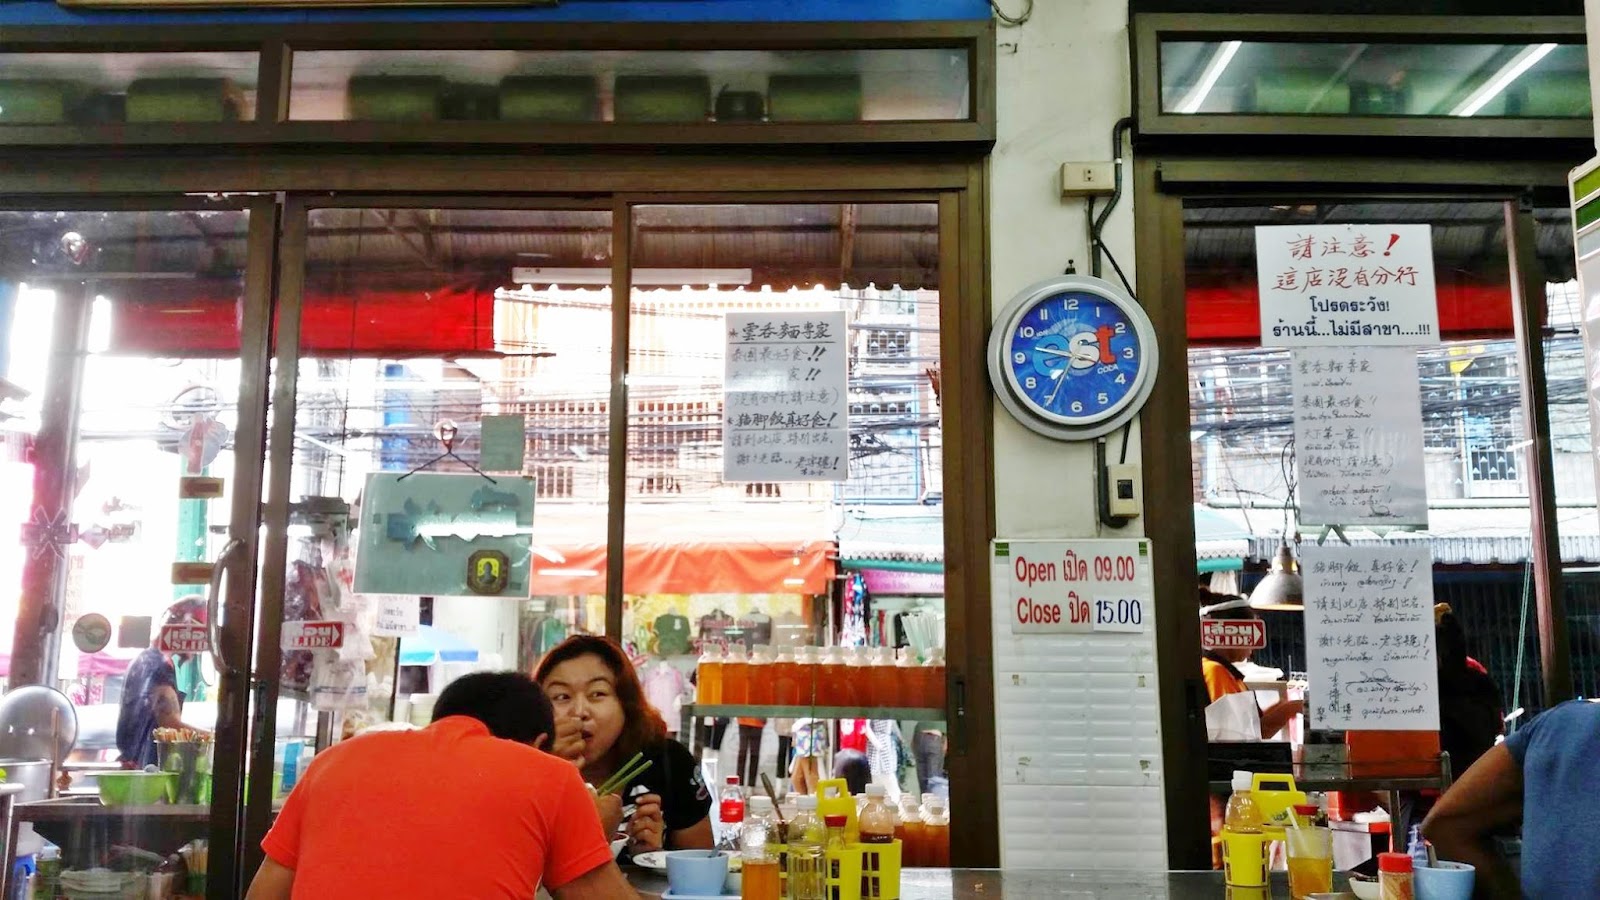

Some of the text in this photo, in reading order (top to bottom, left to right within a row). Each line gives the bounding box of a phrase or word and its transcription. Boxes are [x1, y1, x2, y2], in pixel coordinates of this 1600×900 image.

[1064, 299, 1079, 310] 12
[1310, 296, 1390, 312] โปรดระวัง!
[1040, 309, 1048, 320] 11
[1096, 307, 1100, 318] 1
[1020, 327, 1034, 338] 10
[1115, 322, 1126, 334] 2
[1033, 325, 1116, 377] est
[1123, 348, 1134, 358] 3
[1014, 352, 1026, 364] 9
[1025, 377, 1037, 389] 8
[1115, 373, 1126, 384] 4
[1043, 395, 1053, 407] 7
[1097, 393, 1108, 404] 5
[1071, 401, 1082, 413] 6
[1015, 549, 1135, 587] Open เปิด 09.00
[1017, 590, 1142, 625] Close ปิด 15.00
[293, 637, 331, 647] LIDE
[1204, 635, 1253, 646] SLIDE
